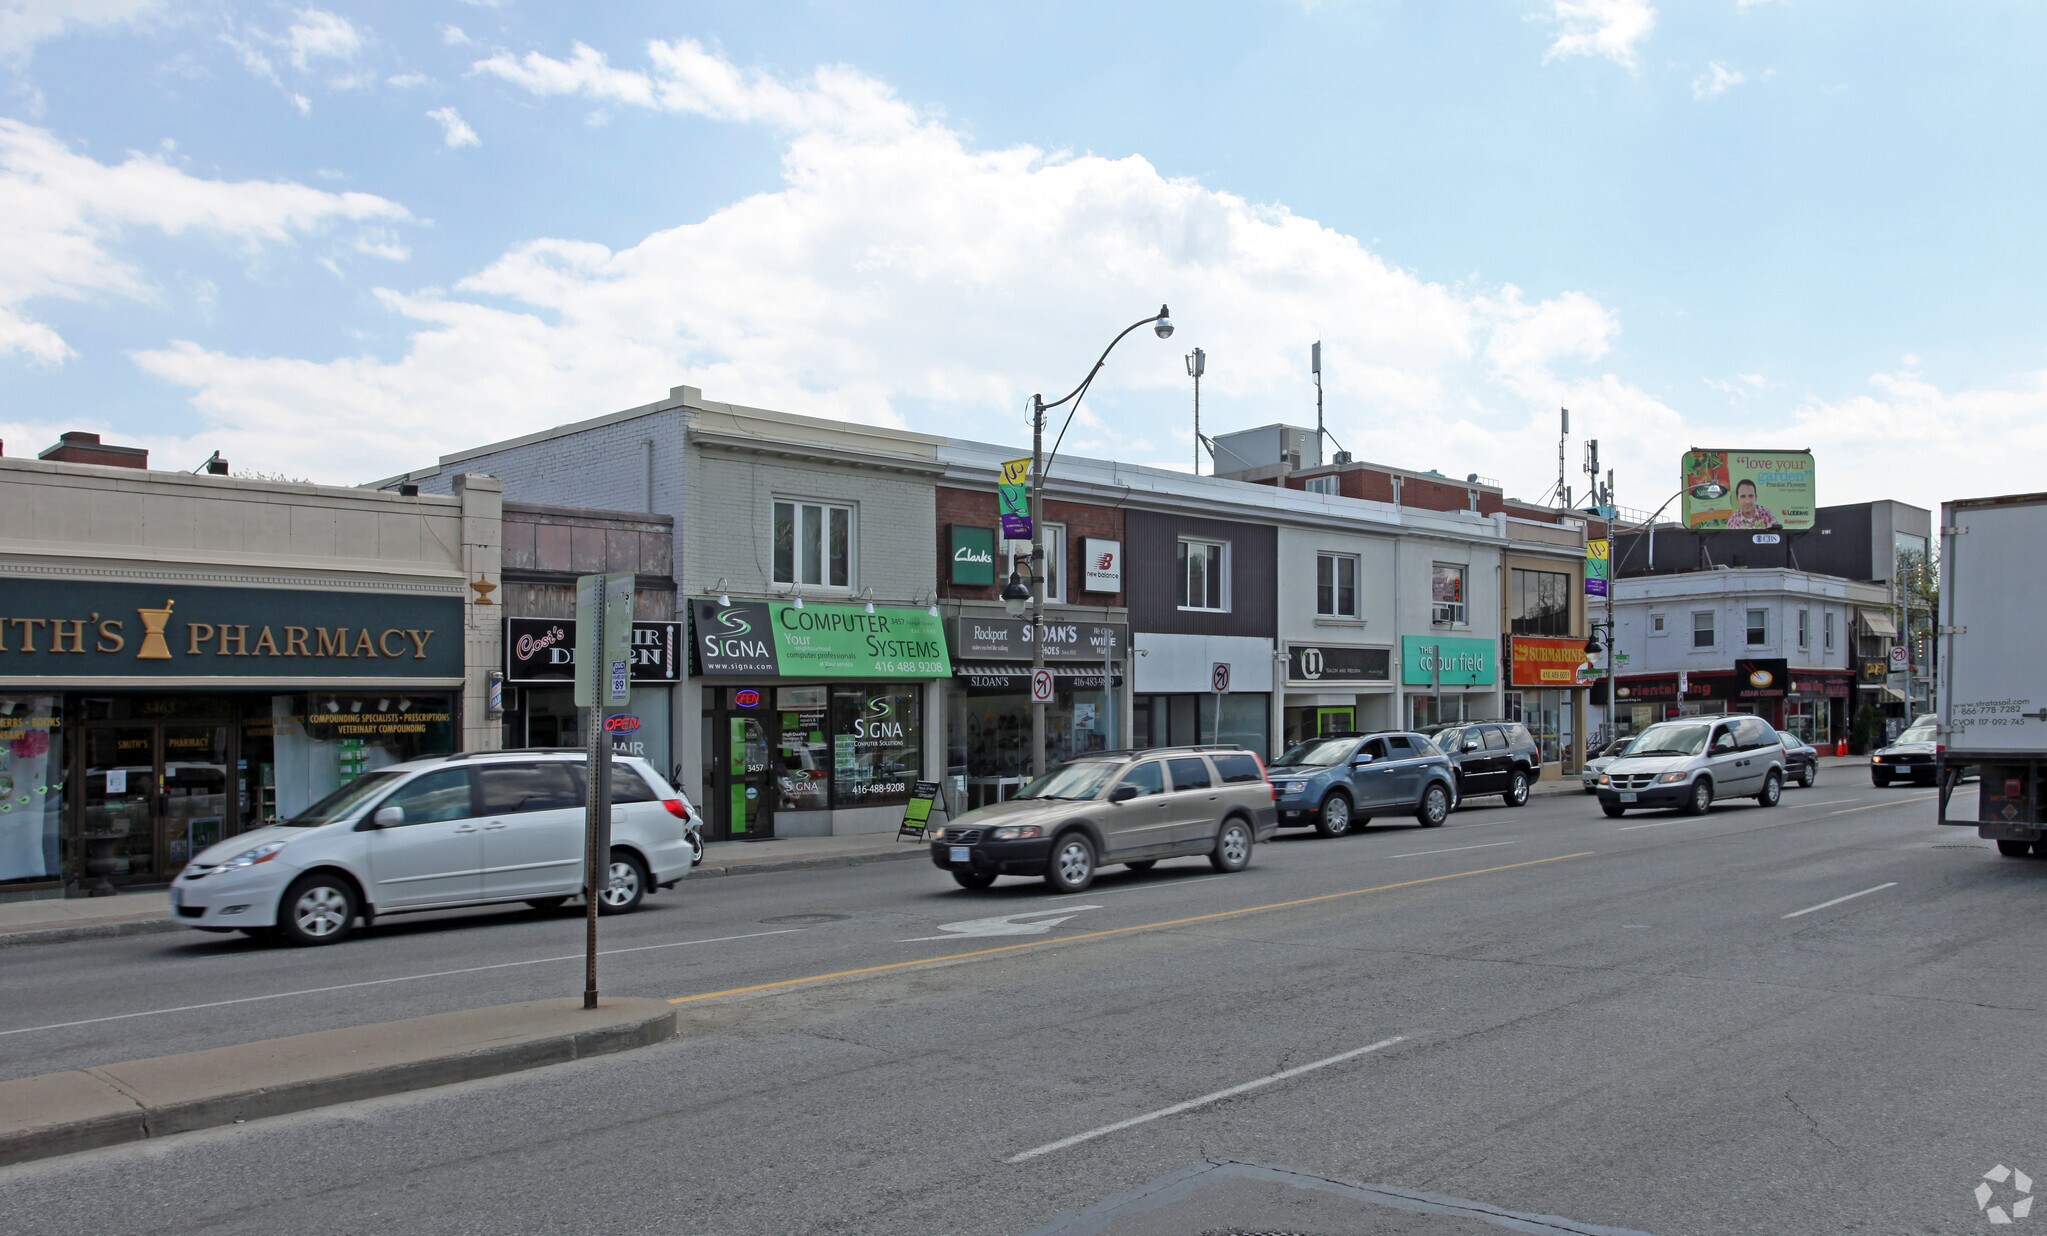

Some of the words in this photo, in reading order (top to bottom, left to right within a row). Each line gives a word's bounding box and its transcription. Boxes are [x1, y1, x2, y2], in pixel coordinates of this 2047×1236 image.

[1775, 459, 1807, 473] your
[954, 547, 992, 563] Clarks
[1097, 571, 1119, 579] balance
[780, 607, 891, 633] COMPUTER
[632, 629, 662, 646] IR
[784, 633, 811, 646] Your
[974, 625, 1008, 643] Rockport
[1022, 625, 1078, 643] SOAN'S
[186, 622, 435, 659] PHARMACY
[705, 635, 769, 658] SIGNA
[866, 635, 940, 658] SYSTEMS
[786, 652, 817, 660] computer
[817, 652, 856, 660] professionals
[1041, 646, 1060, 655] HOES
[1420, 646, 1433, 654] THE
[708, 663, 773, 671] www.signa.com
[875, 662, 894, 672] 416
[897, 662, 916, 673] 488
[918, 662, 943, 673] 9208
[1420, 656, 1456, 671] coour
[1459, 652, 1484, 671] field
[971, 677, 1009, 687] SLOAN'S
[1689, 683, 1712, 696] ing
[735, 693, 760, 704] OPEN
[1953, 698, 2030, 708] www.stratasoil.com
[309, 714, 360, 723] COMPOUNDING
[361, 713, 399, 722] SPECIALISTS
[403, 713, 450, 722] PRESCRIPTIONS
[604, 717, 641, 731] OPEN
[1952, 718, 1975, 726] CVOR
[1978, 718, 2025, 726] 117-092-745
[338, 724, 377, 734] VETERINARY
[378, 724, 426, 733] COMPOUNDING
[854, 719, 903, 739] SIGNA
[118, 740, 148, 749] SMITH'S
[169, 738, 209, 747] PHARMACY
[747, 764, 764, 773] 3457
[785, 780, 818, 792] SGNA
[852, 782, 905, 794] 416-488-9208
